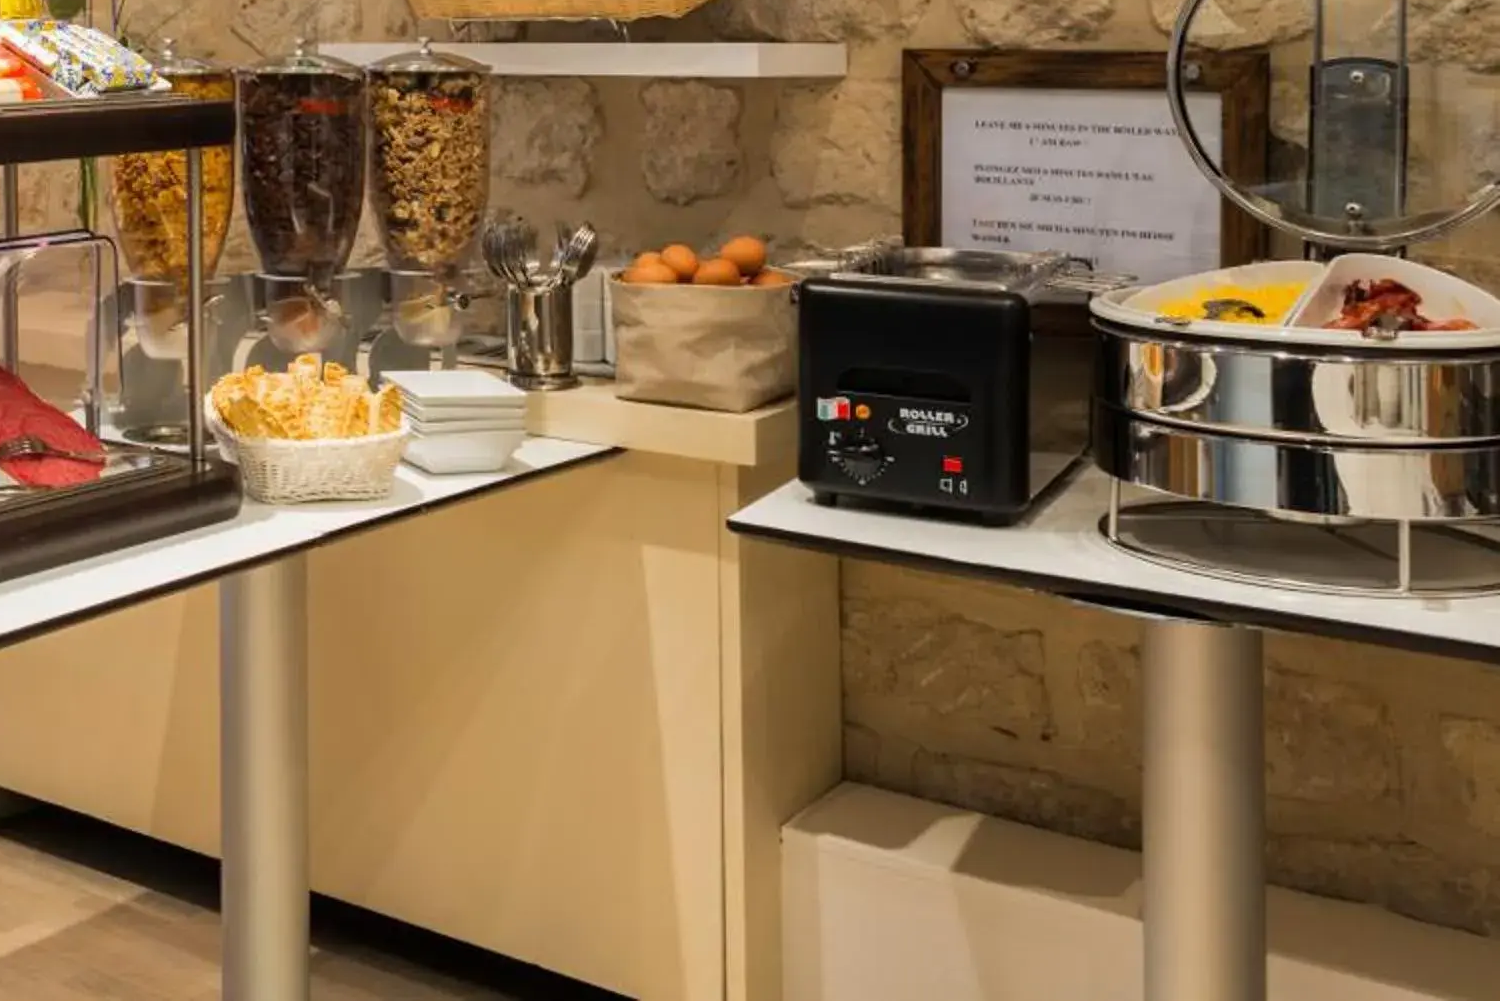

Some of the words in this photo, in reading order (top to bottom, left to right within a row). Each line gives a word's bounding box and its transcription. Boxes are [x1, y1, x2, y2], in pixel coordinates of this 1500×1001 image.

[974, 120, 1006, 129] LEAVE
[1090, 125, 1111, 134] THE
[1153, 128, 1185, 137] WAT
[900, 408, 954, 423] ROLLER
[906, 424, 948, 437] GRILL
